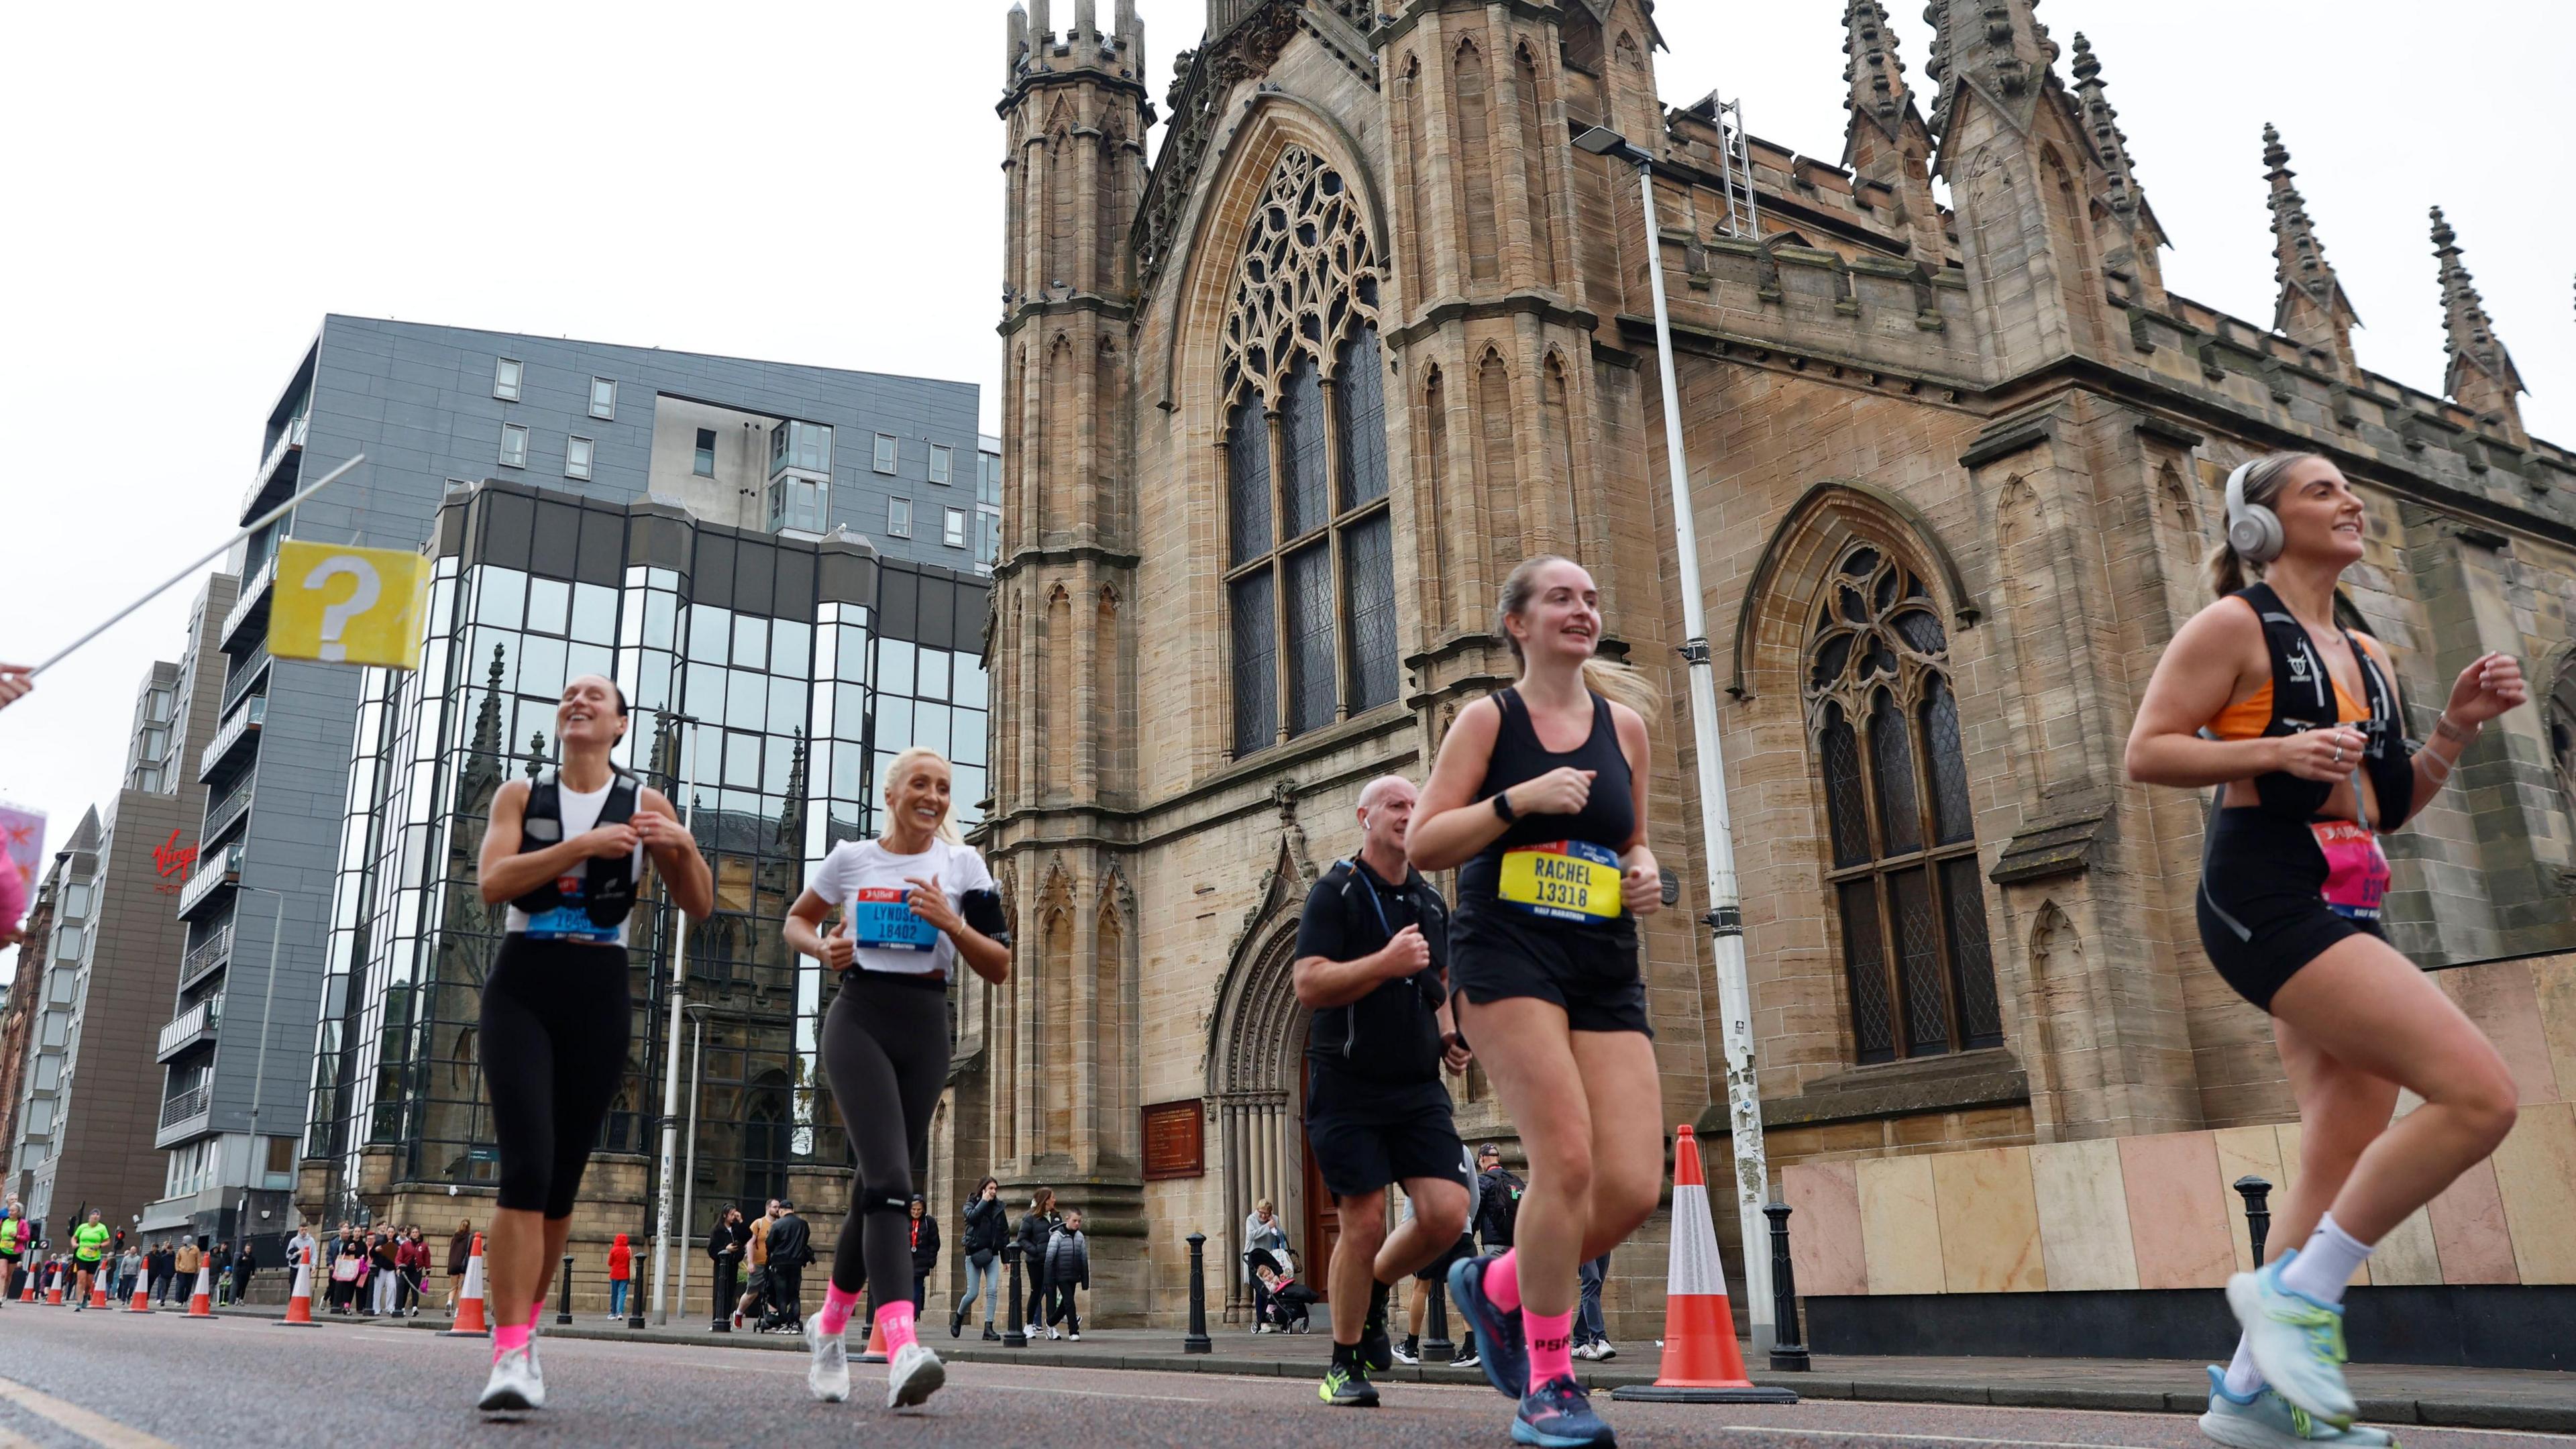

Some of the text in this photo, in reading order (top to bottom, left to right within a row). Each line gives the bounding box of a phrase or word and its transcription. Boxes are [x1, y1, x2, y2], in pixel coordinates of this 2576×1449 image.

[152, 828, 197, 881] Virgi
[1535, 858, 1592, 885] RACHEL
[154, 884, 182, 894] HOT
[1536, 881, 1587, 907] 13318
[879, 923, 917, 940] 18402
